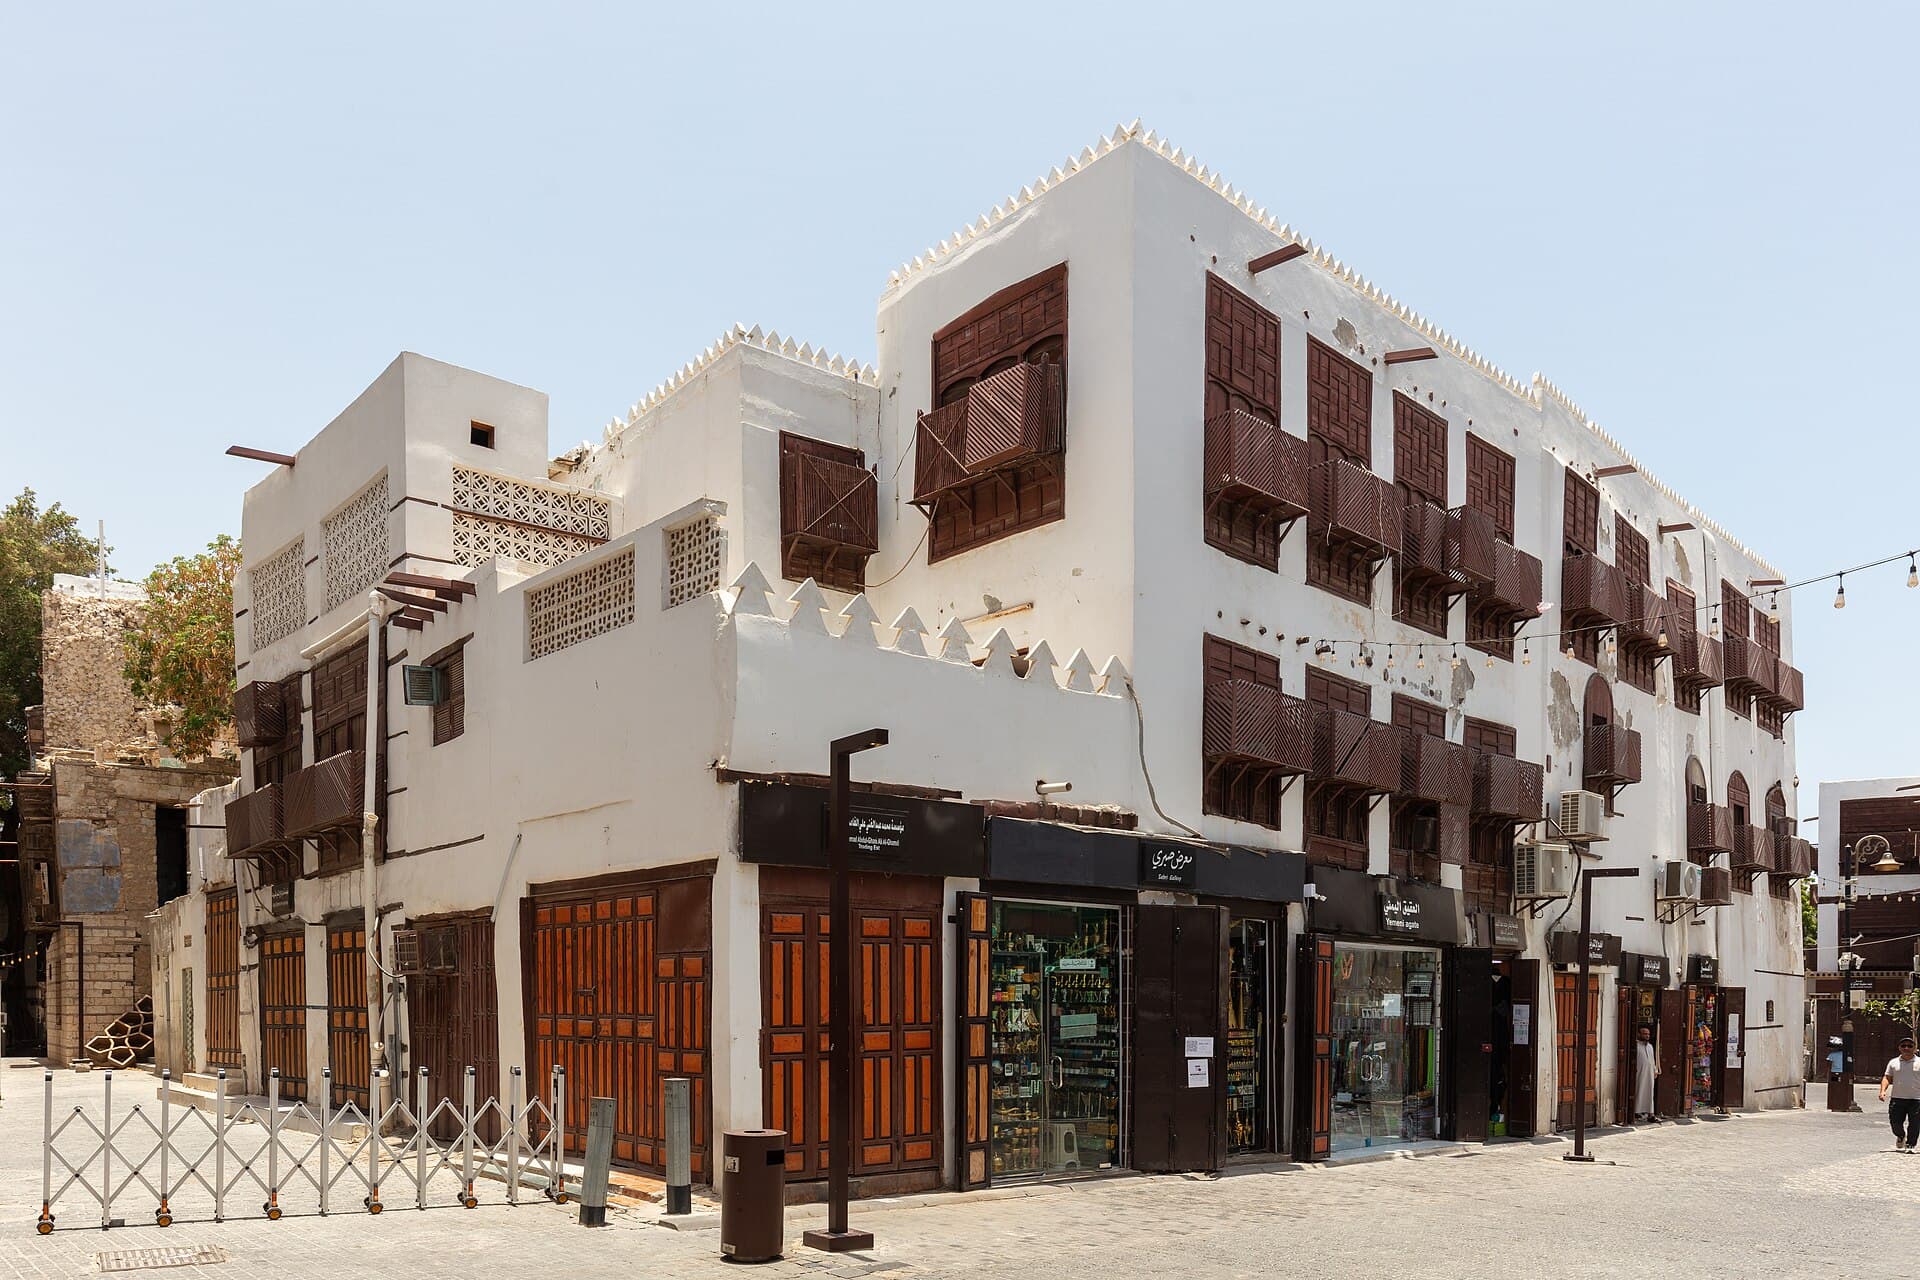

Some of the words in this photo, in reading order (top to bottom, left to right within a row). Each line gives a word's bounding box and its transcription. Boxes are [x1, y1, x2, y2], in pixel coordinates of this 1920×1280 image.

[1152, 849, 1175, 870] صبري
[1171, 850, 1193, 870] معرض
[1383, 899, 1402, 916] اليمني
[1402, 900, 1420, 916] العقيق
[1385, 917, 1405, 927] Yemeni
[1405, 920, 1420, 930] agate
